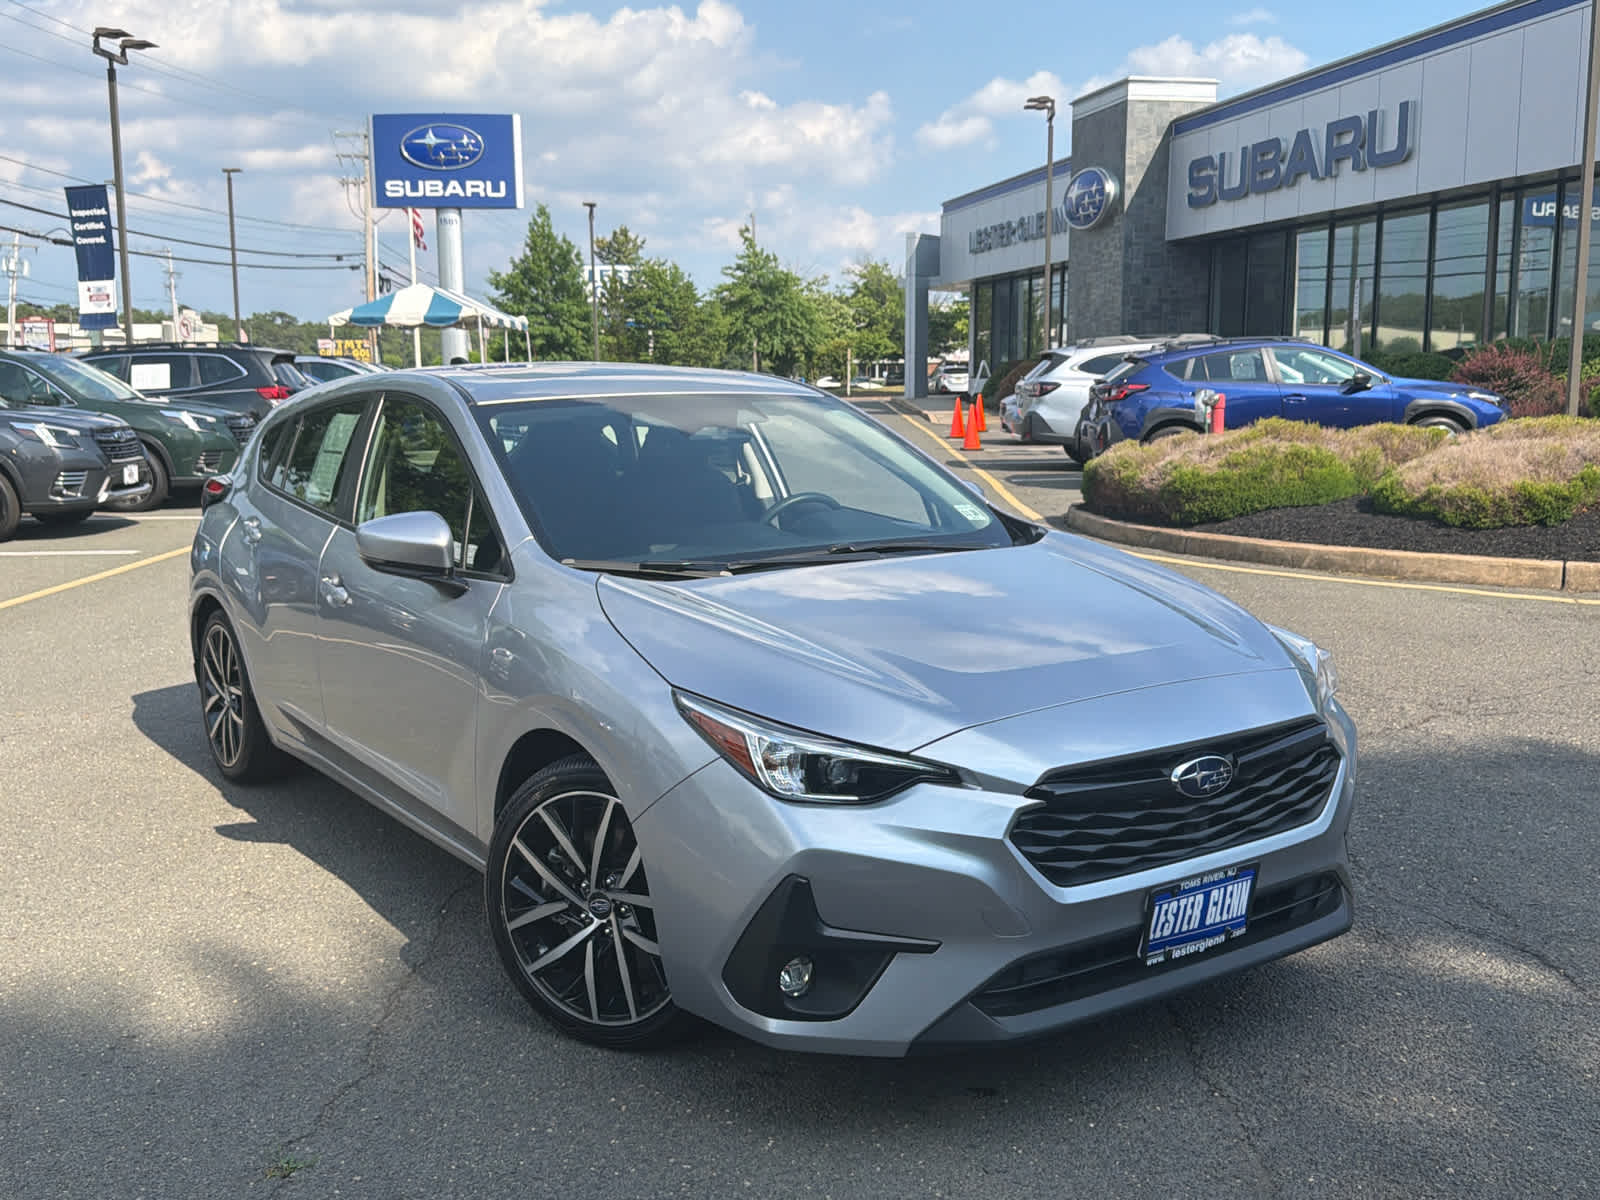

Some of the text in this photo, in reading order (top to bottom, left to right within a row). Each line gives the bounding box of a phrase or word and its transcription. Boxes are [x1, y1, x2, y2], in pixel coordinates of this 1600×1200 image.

[1187, 100, 1412, 209] SUBARU
[384, 180, 507, 198] SUBARU
[1180, 878, 1201, 891] TOMS
[1149, 880, 1251, 940] LESTER GLENN
[1172, 935, 1225, 959] lesterglenn
